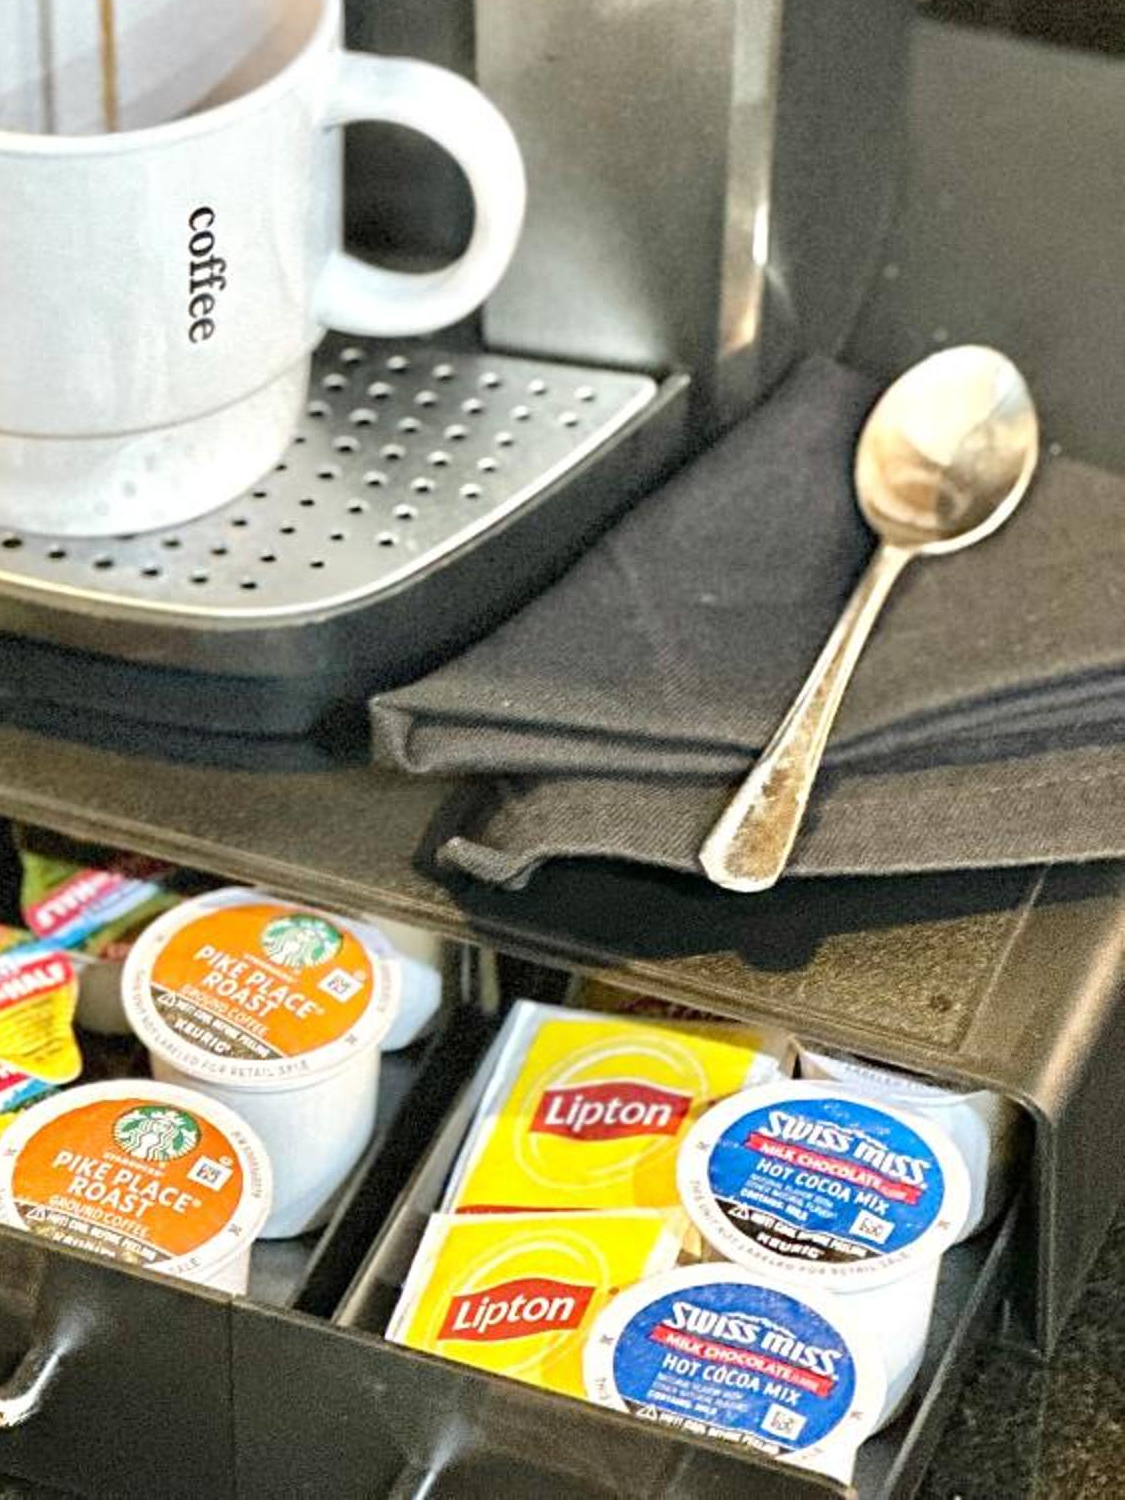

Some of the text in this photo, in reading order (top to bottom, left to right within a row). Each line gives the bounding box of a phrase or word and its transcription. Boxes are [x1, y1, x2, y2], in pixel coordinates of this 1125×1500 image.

[188, 206, 227, 344] coffee
[193, 945, 249, 979] PIKE
[202, 971, 278, 1019] ROAST
[544, 1095, 673, 1133] Lipton
[758, 1111, 856, 1152] SWISS
[52, 1150, 113, 1179] PIKE
[67, 1175, 154, 1218] ROAST
[755, 1158, 891, 1217] HOT COCOA MIX
[452, 1294, 576, 1334] Lipton
[660, 1301, 762, 1344] SWISS
[665, 1331, 702, 1354] MILK
[704, 1345, 791, 1381] CHOCOLATE
[663, 1352, 698, 1376] HOT
[701, 1363, 760, 1393] COCOA
[763, 1381, 803, 1406] MIX
